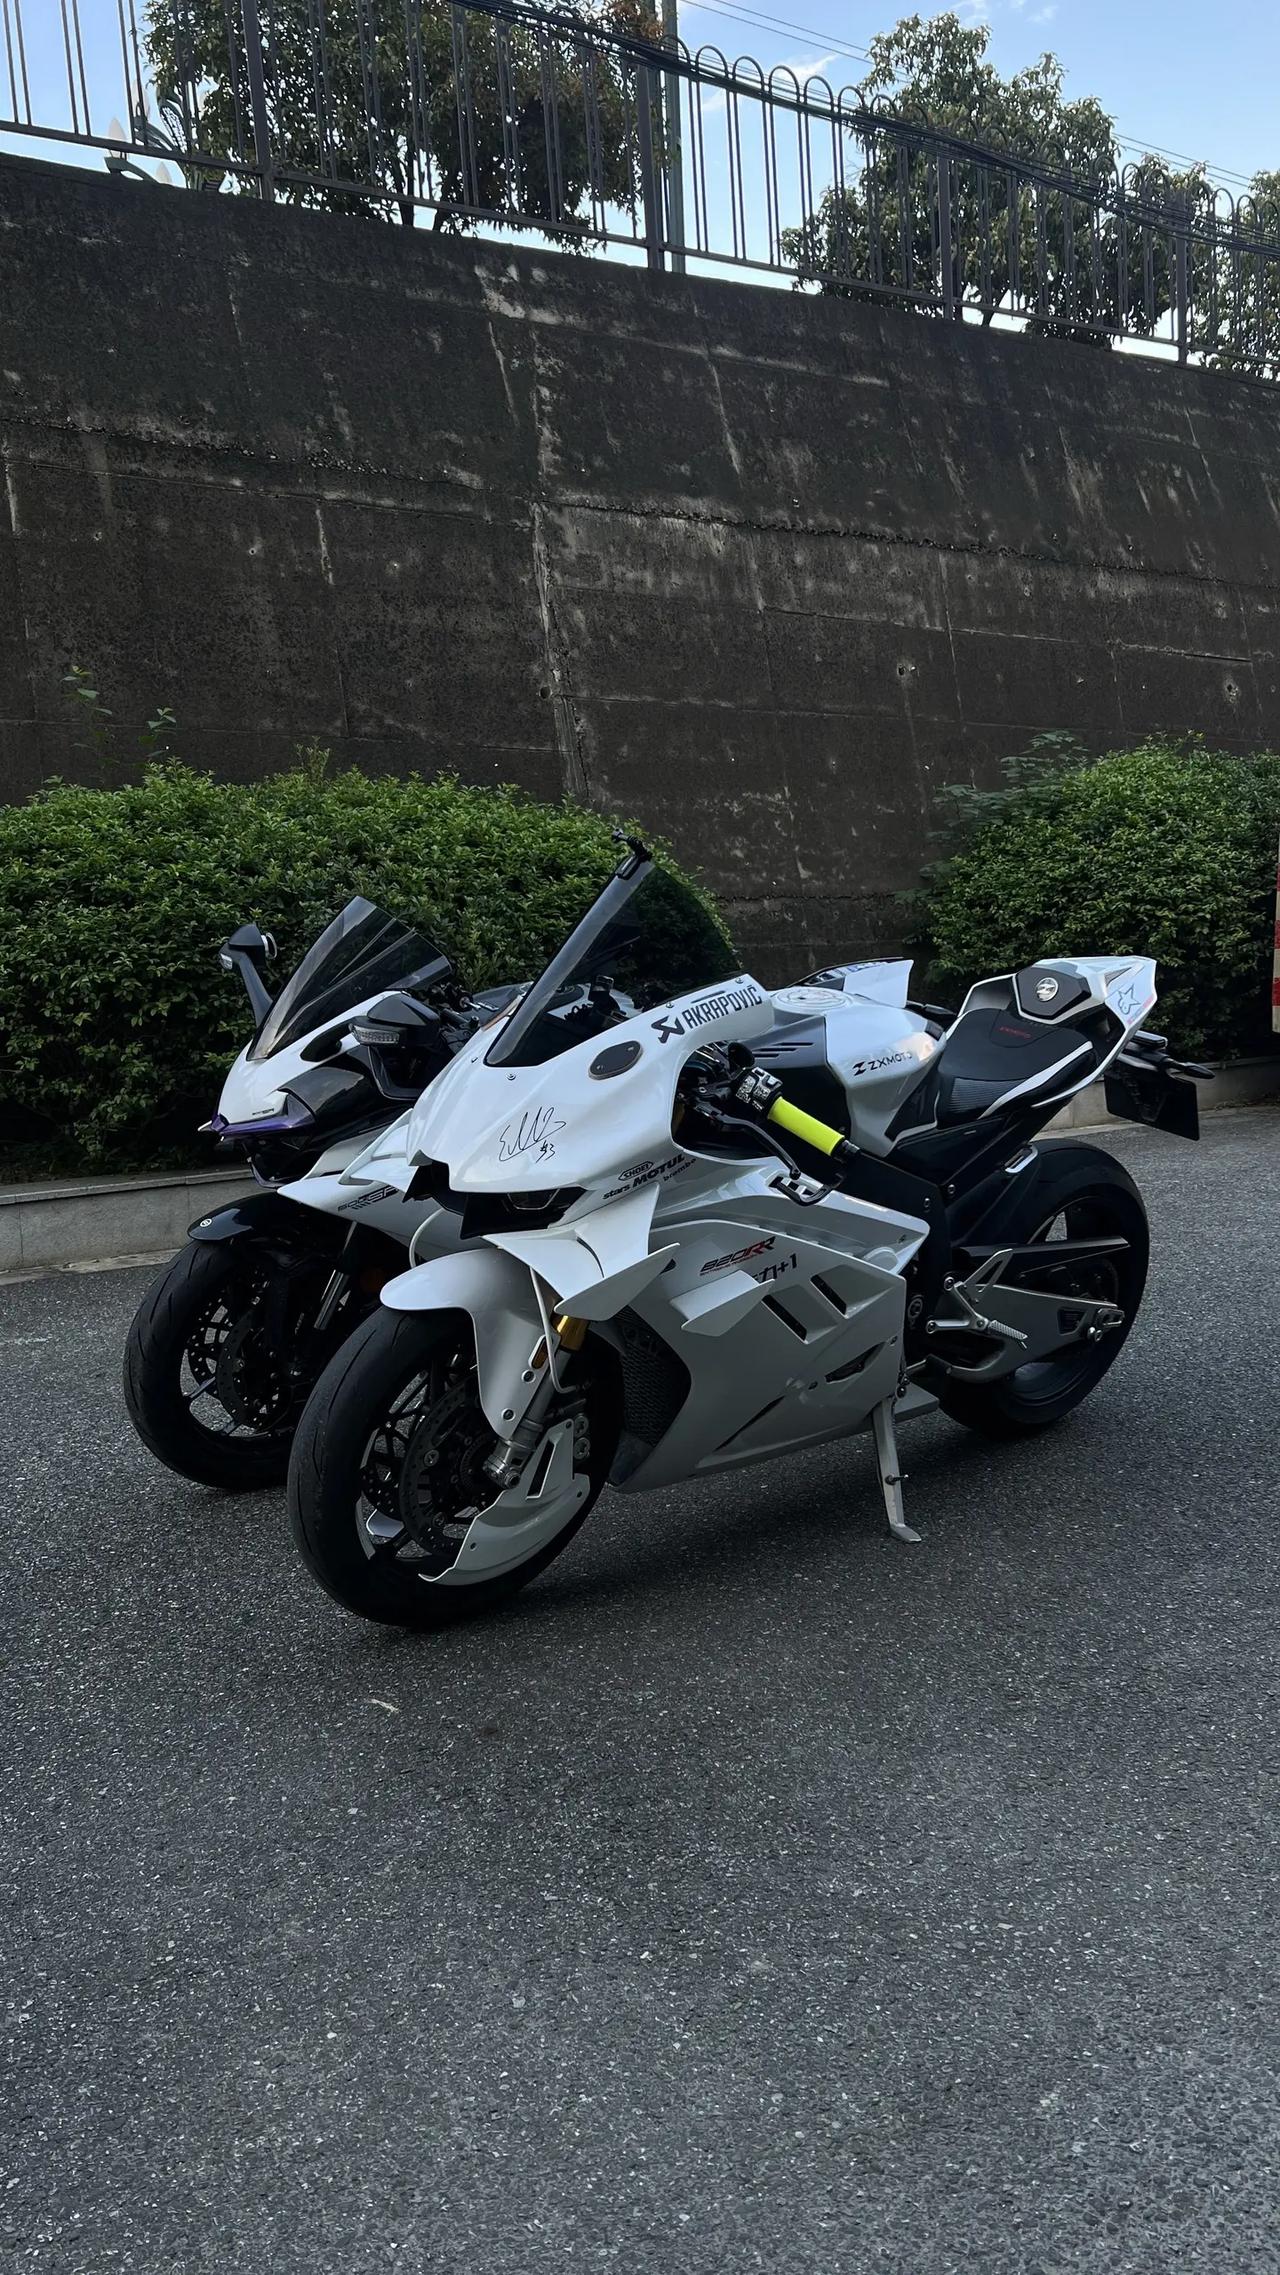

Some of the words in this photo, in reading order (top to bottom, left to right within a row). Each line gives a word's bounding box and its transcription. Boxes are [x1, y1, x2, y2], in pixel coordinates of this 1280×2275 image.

[622, 1162, 651, 1178] SHOEI
[633, 1154, 685, 1187] MOTUL
[663, 1158, 697, 1181] brembo
[602, 1184, 630, 1199] stars
[700, 1236, 776, 1272] 820RR
